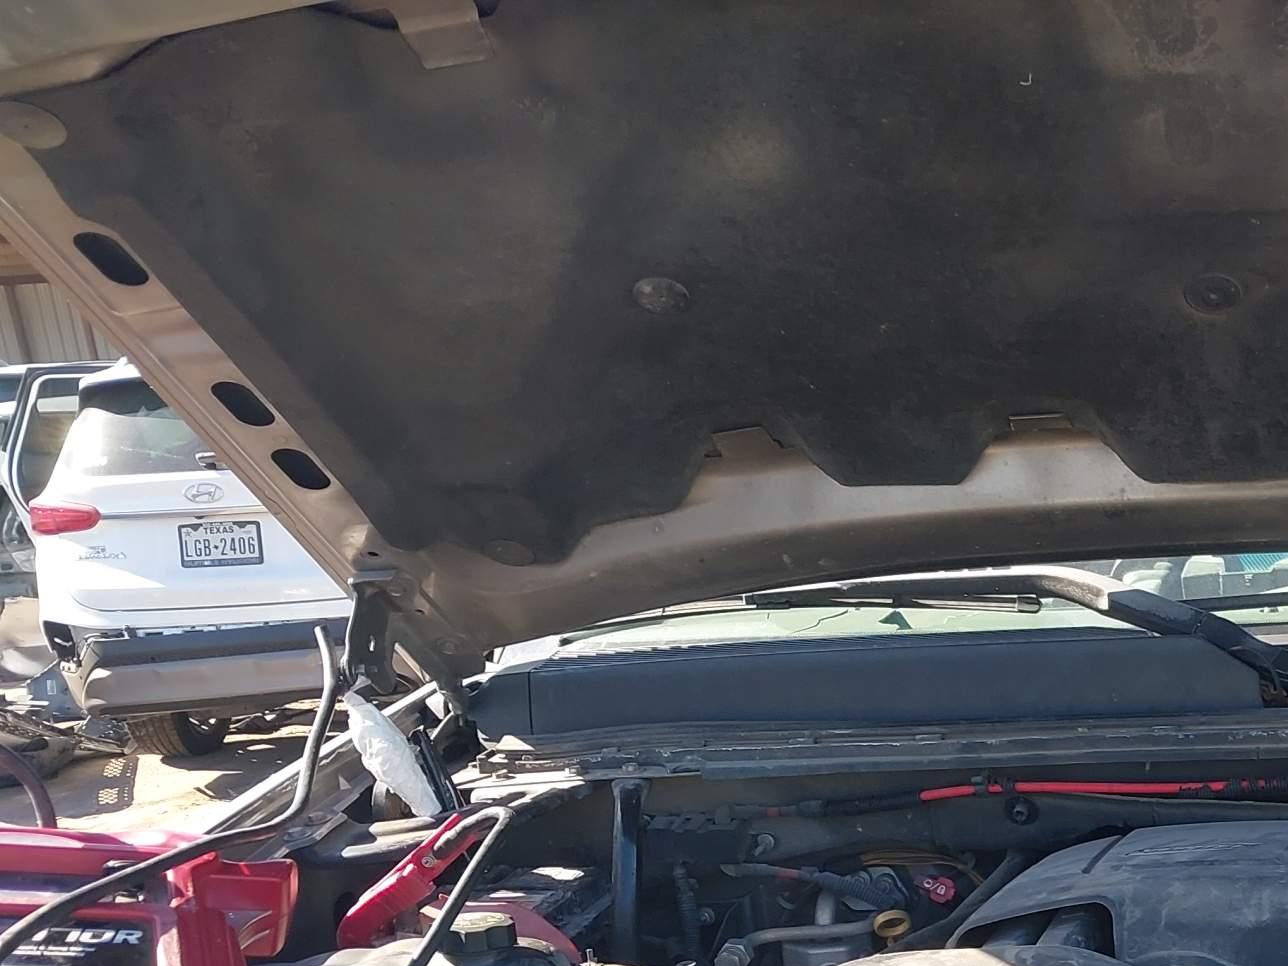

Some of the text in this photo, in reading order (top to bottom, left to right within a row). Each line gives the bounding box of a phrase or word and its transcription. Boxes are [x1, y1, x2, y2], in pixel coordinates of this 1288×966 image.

[203, 526, 234, 535] TEXAS
[185, 536, 256, 558] LGB 2406
